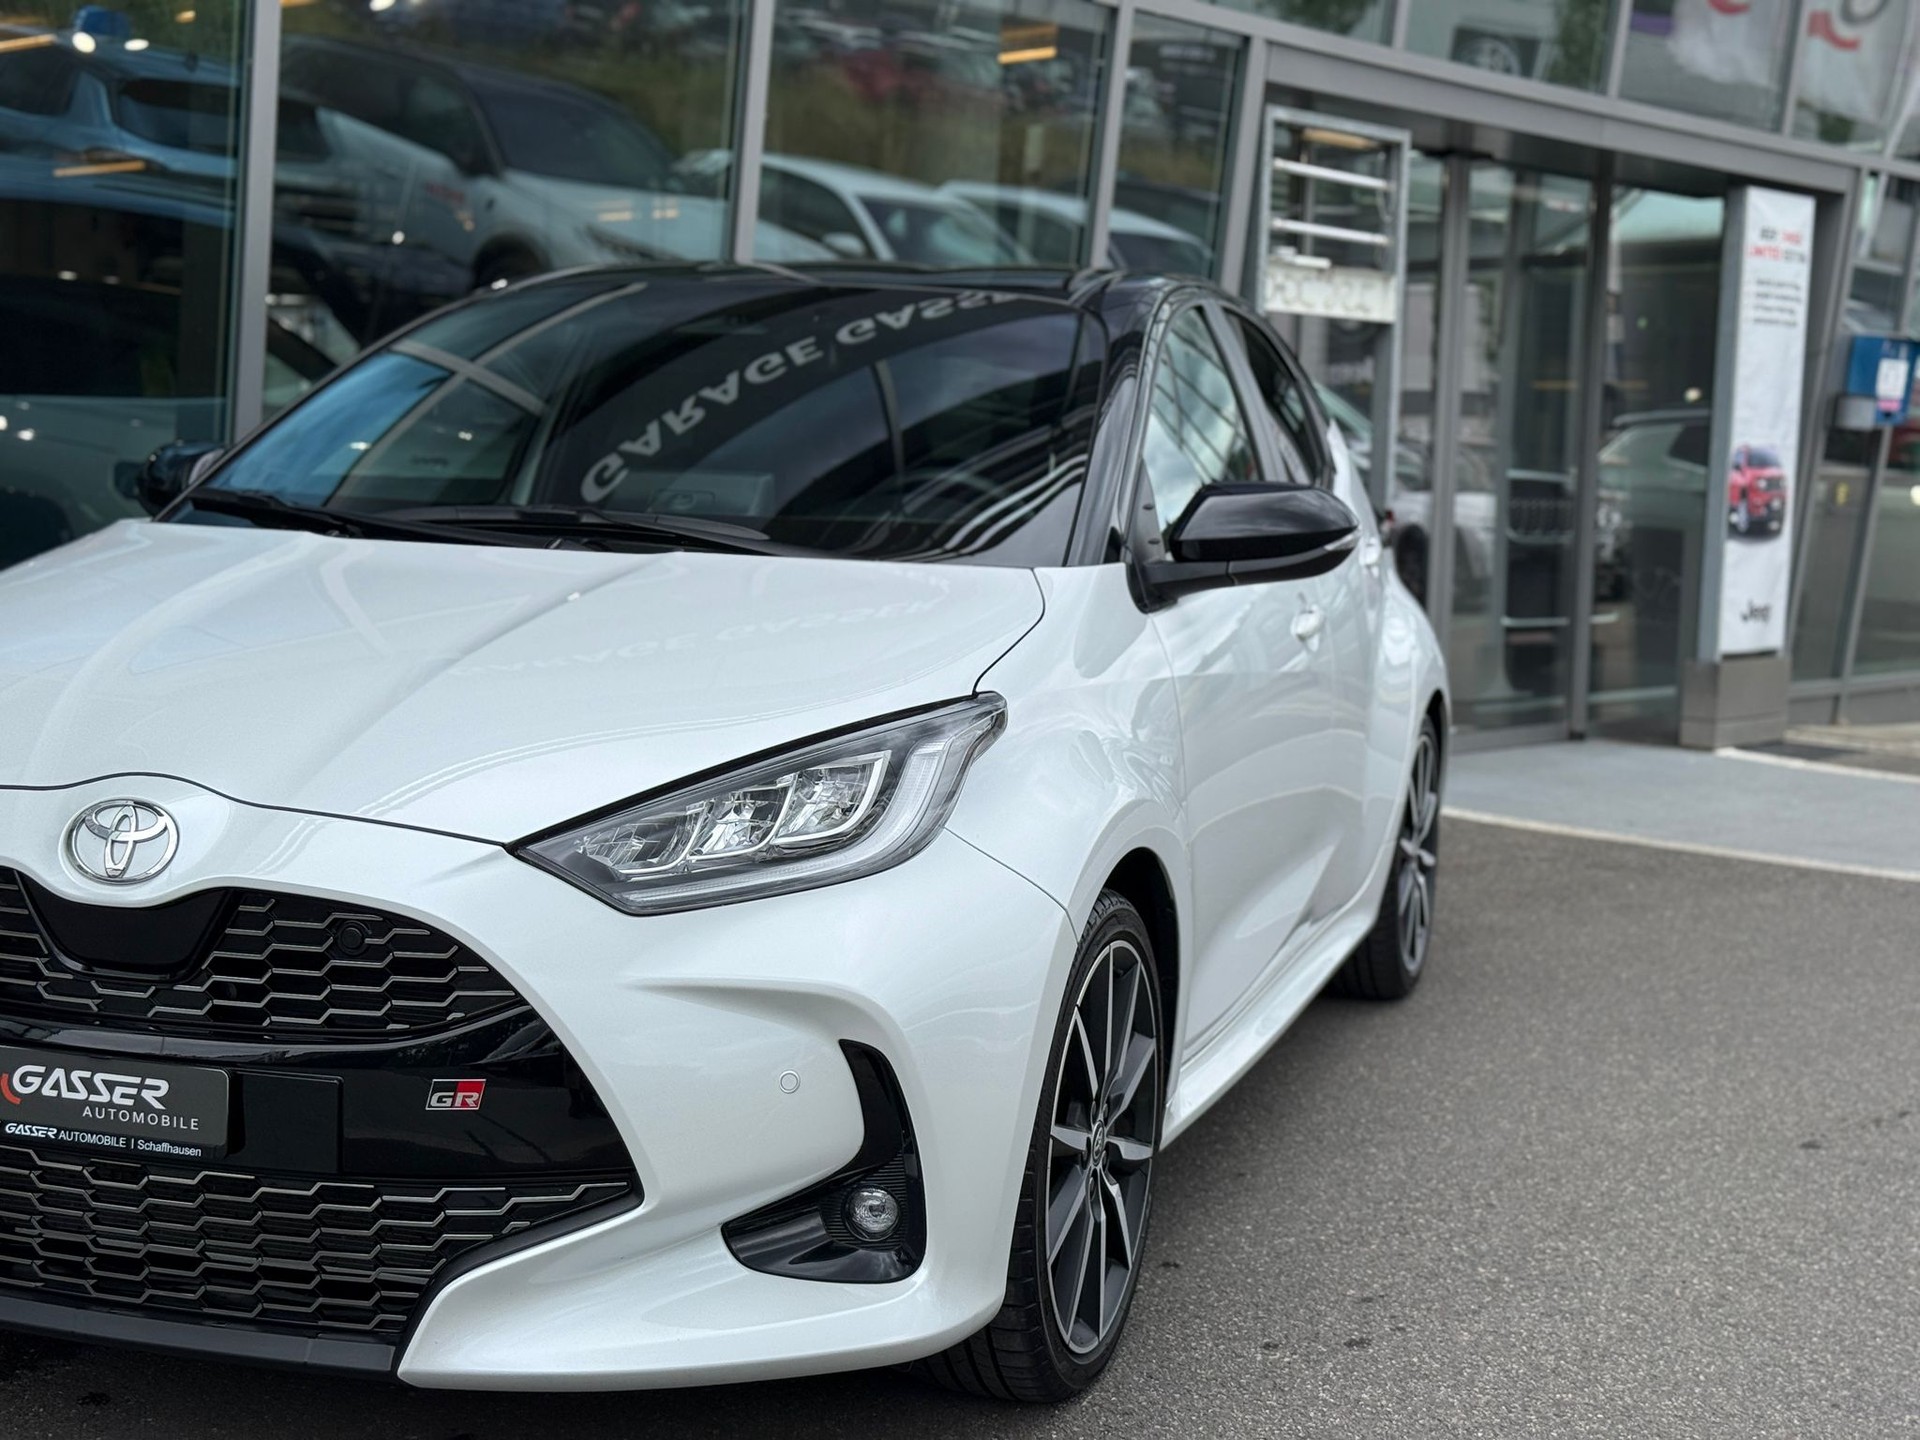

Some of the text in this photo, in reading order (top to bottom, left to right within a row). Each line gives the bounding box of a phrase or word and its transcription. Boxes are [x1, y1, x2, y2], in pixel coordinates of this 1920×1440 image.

[12, 1064, 170, 1110] GASSER
[430, 1092, 480, 1107] GR
[82, 1106, 200, 1131] AUTOMOBILE
[5, 1122, 58, 1139] GASSER
[59, 1130, 127, 1148] AUTOMOBILE
[137, 1140, 202, 1158] Schaffhausen
